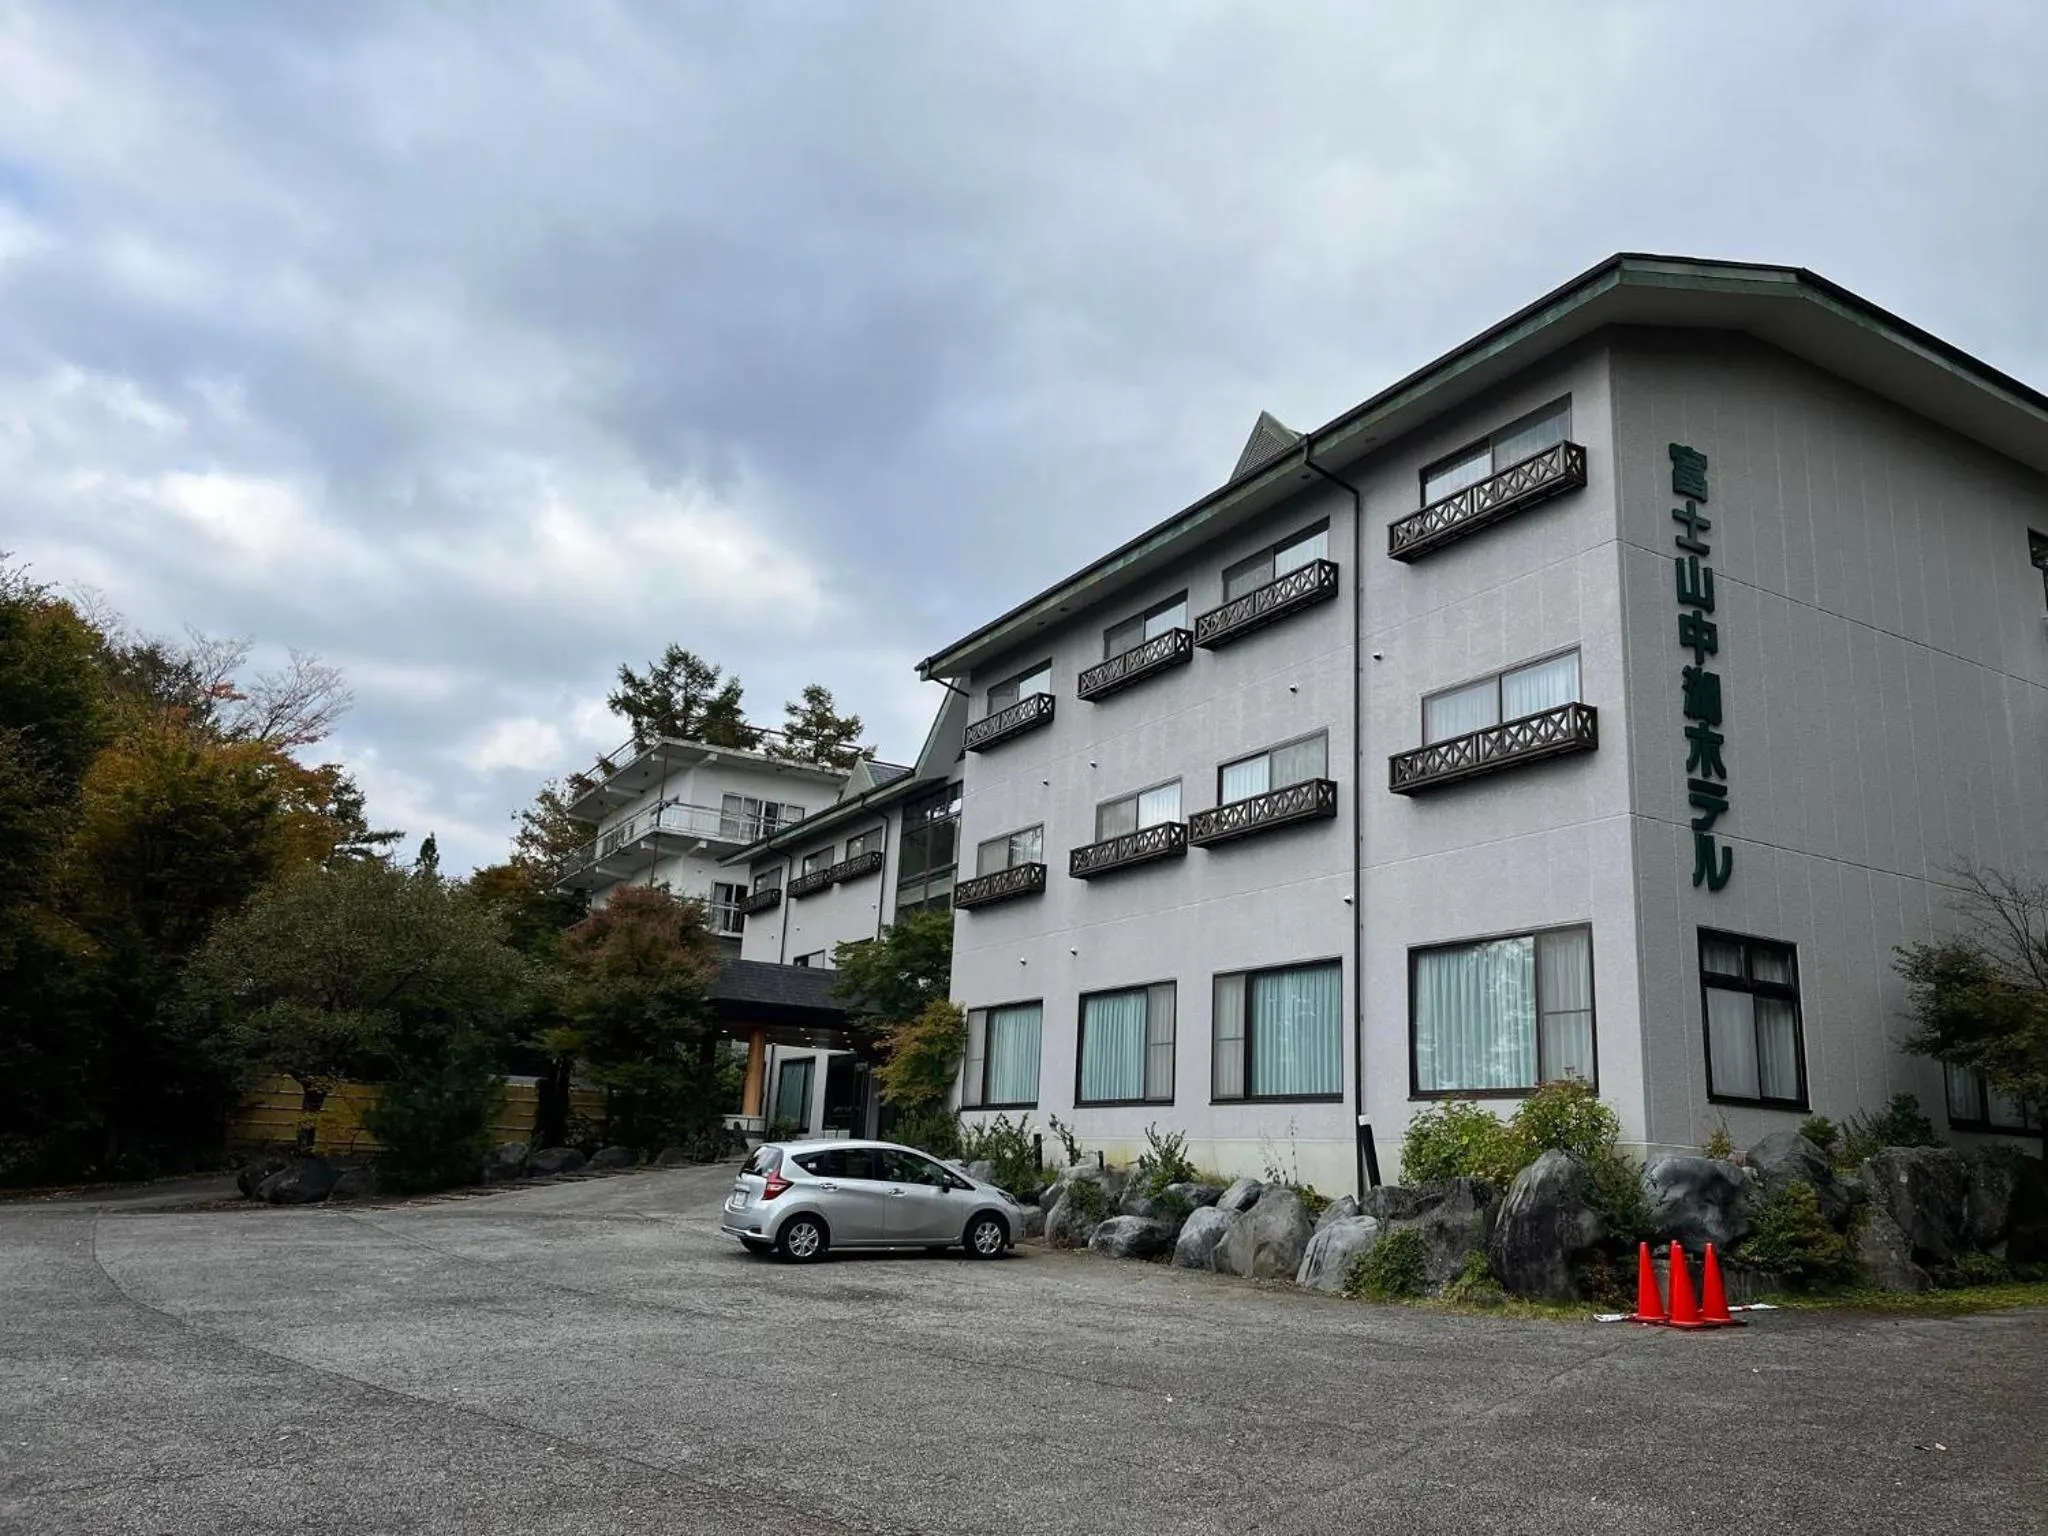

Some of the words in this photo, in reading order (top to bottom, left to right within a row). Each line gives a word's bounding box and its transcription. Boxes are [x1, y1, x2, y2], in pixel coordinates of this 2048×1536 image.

[1668, 442, 1733, 891] 富士山中湖ホテル
